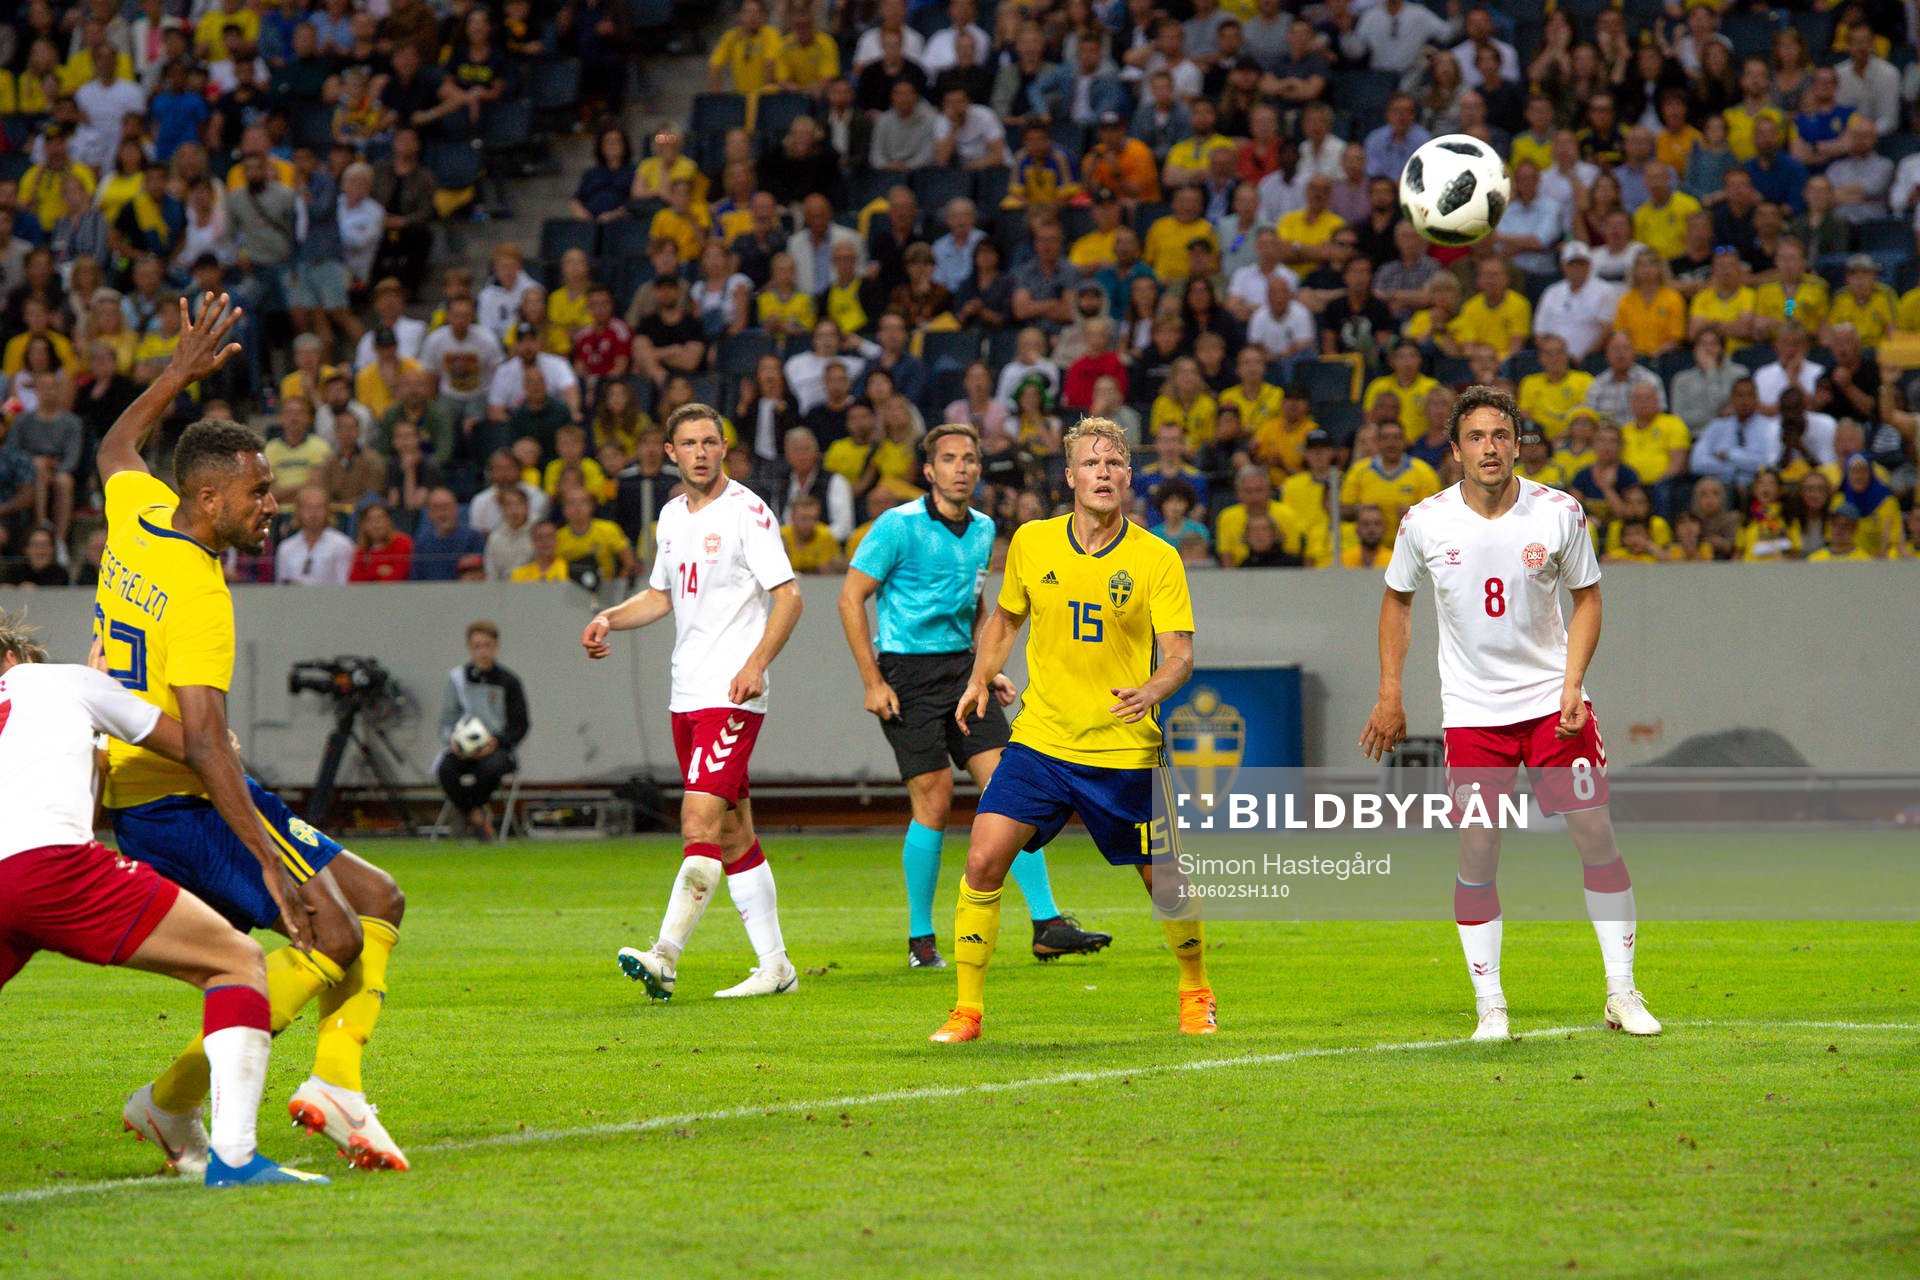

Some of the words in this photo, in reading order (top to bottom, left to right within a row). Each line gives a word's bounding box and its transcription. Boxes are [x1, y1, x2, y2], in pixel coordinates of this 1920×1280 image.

[679, 562, 697, 599] 14
[1484, 577, 1505, 617] 8
[1068, 600, 1103, 642] 15
[1571, 756, 1595, 801] 8
[1134, 816, 1170, 856] 15
